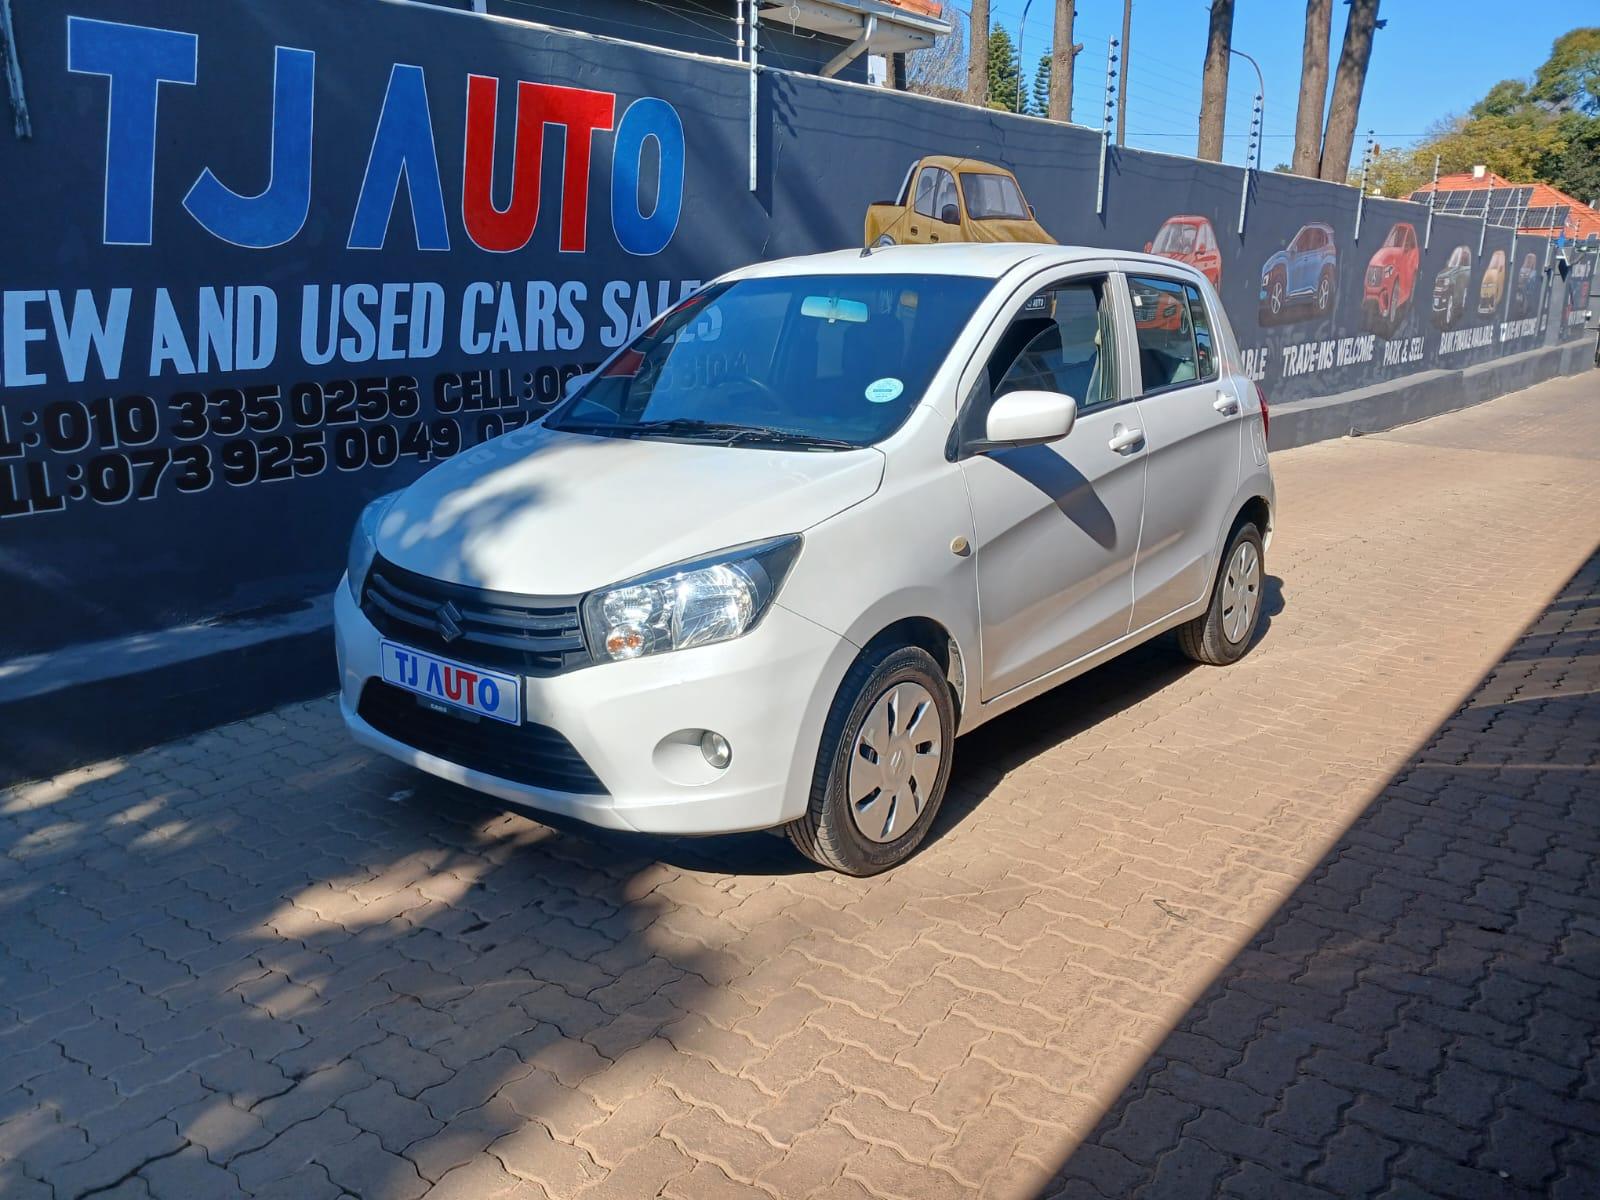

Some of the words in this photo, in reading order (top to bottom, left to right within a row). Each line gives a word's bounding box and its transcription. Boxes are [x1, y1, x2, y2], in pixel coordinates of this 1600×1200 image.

[67, 15, 315, 249] TJ
[347, 63, 686, 256] AUTO
[0, 287, 133, 387] EW
[149, 286, 278, 376] AND
[301, 282, 445, 365] USED
[460, 280, 588, 356] CARS
[169, 385, 282, 441] 335
[292, 376, 420, 428] 0256
[222, 431, 327, 486] 925
[336, 418, 462, 471] 0049
[395, 650, 418, 687] TJ
[426, 662, 500, 712] AUTO
